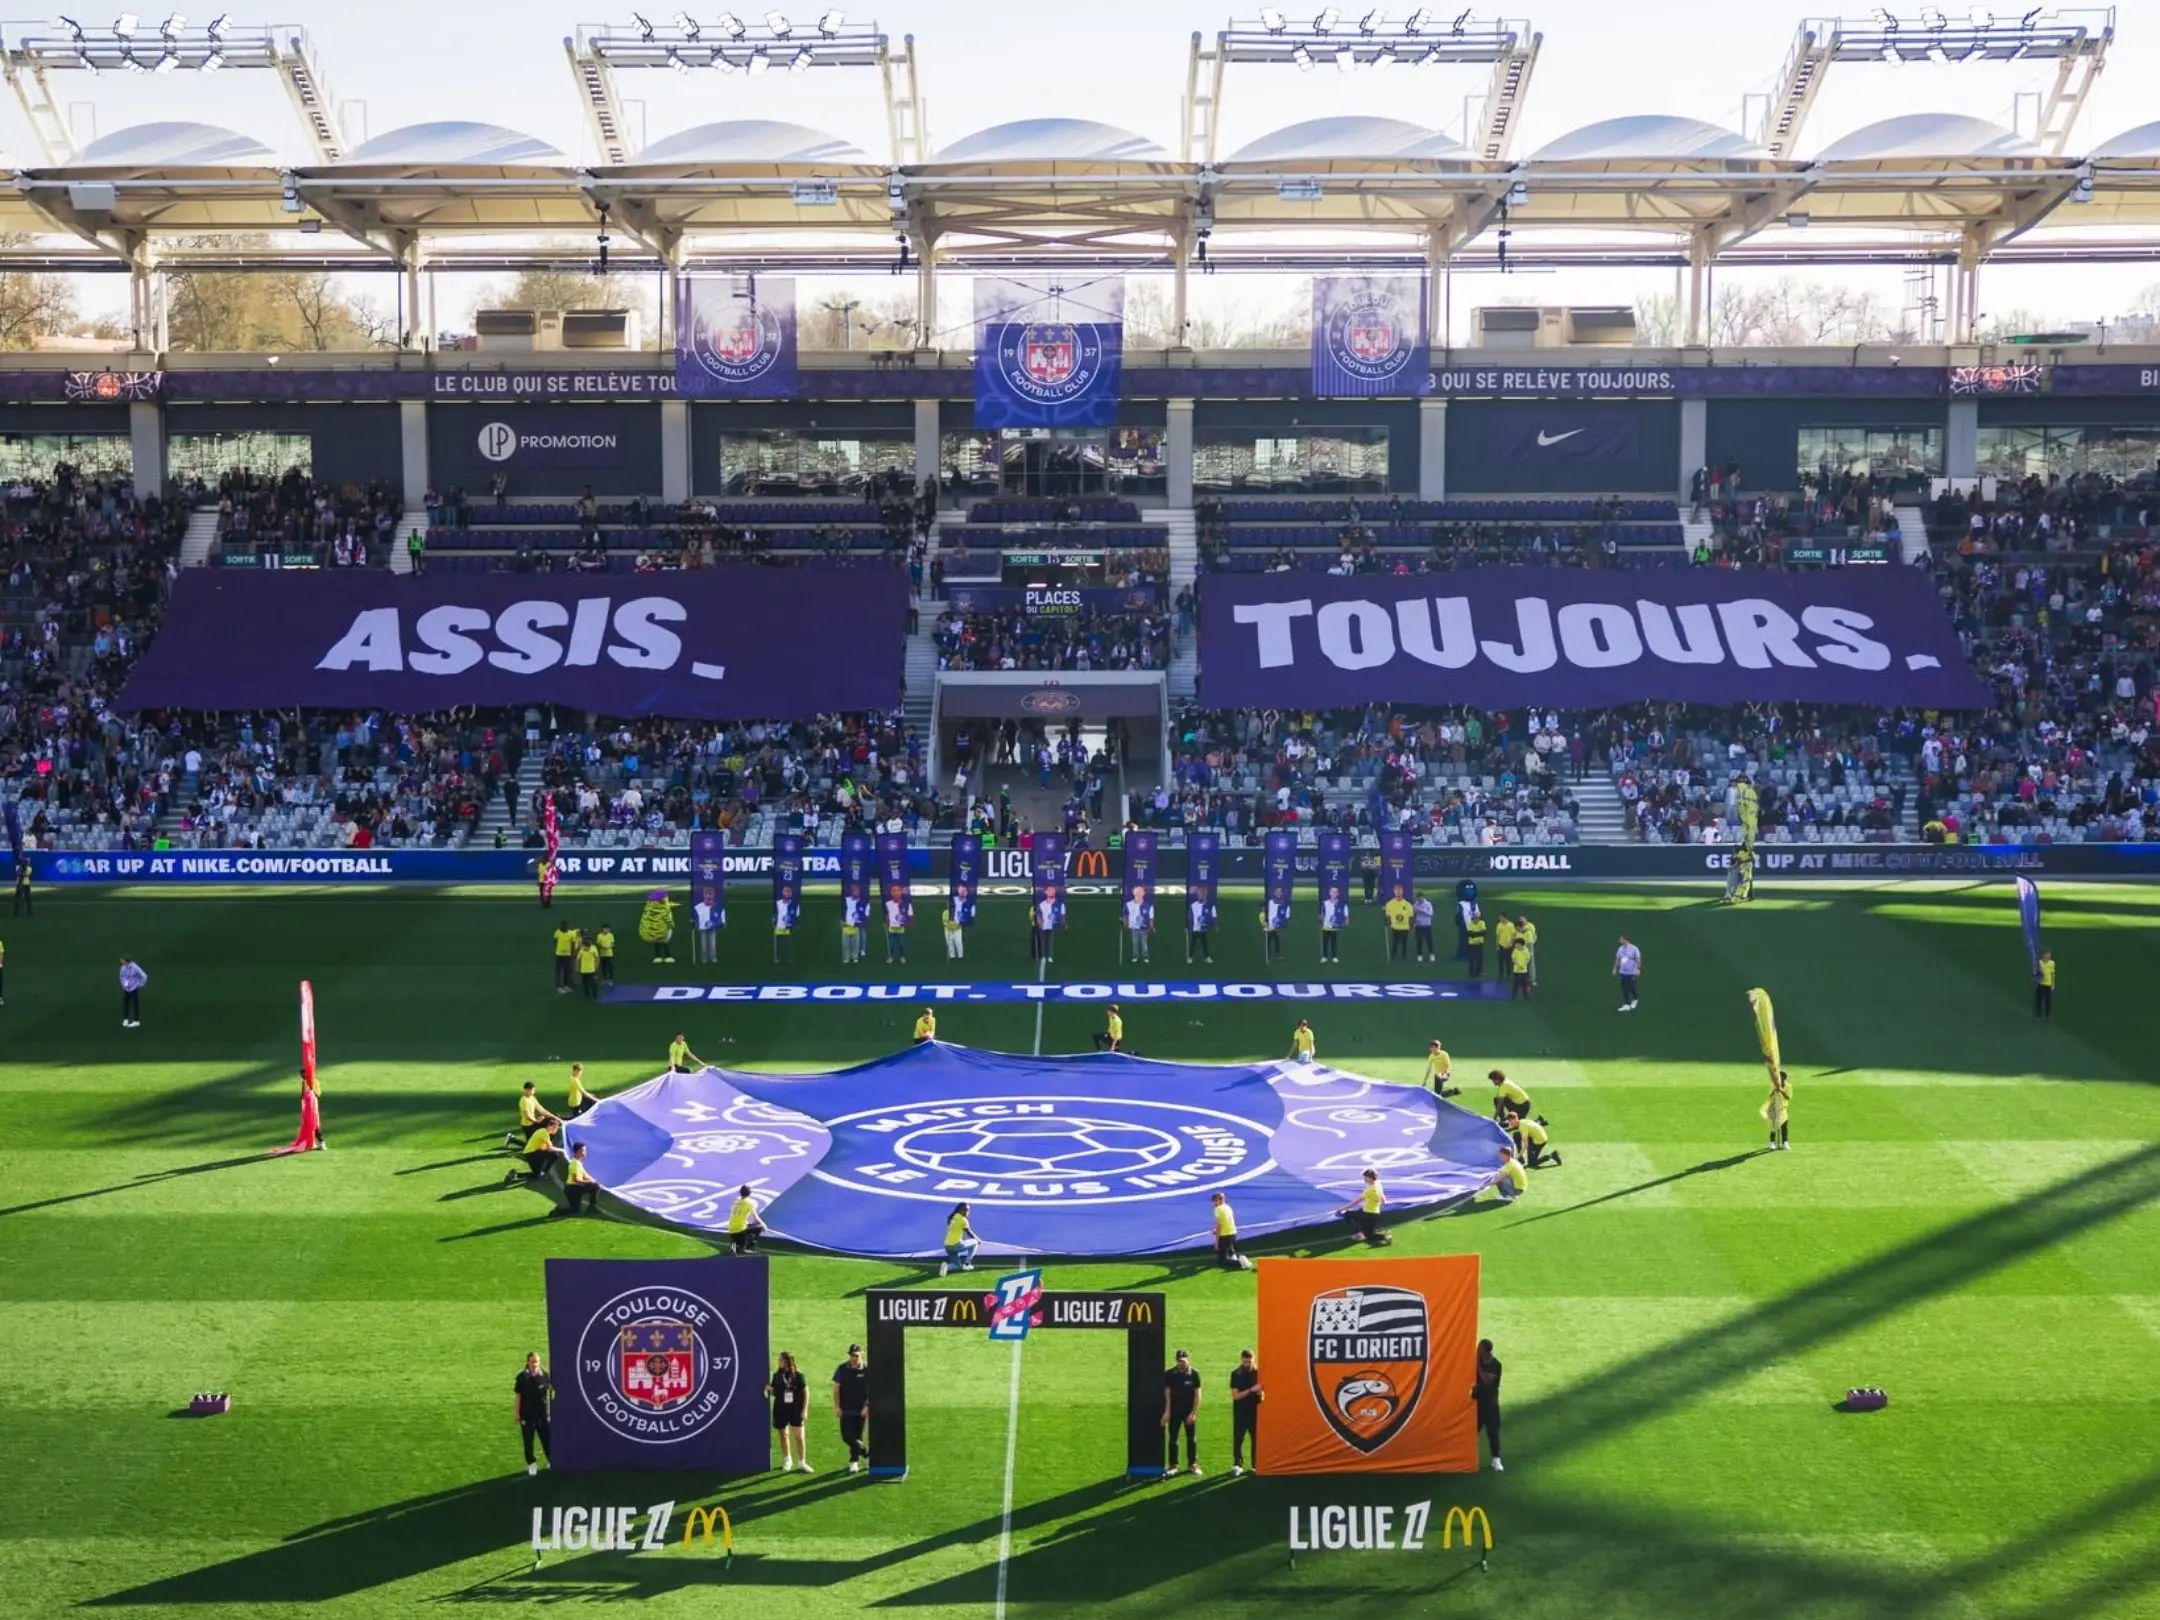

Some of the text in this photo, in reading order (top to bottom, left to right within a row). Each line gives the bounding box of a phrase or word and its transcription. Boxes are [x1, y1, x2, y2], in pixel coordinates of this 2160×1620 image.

[1003, 348, 1014, 357] 19
[1084, 348, 1097, 357] 37
[1339, 350, 1406, 374] FOOTBALL CLUB
[703, 352, 771, 376] FOOTBALL CLUB
[434, 376, 456, 392] LE
[461, 376, 508, 392] CLUB
[512, 376, 542, 394] QUI
[547, 376, 569, 392] SE
[574, 371, 642, 392] RELÈVE
[1011, 370, 1089, 397] FOOTBALL CLUB
[1442, 372, 1470, 390] QUI
[1476, 372, 1498, 388] SE
[1503, 368, 1571, 389] RELÈVE
[1577, 372, 1676, 389] TOUJOURS.
[520, 435, 617, 448] PROMOTION
[226, 553, 314, 569] SORTIE 11 SORTIE
[1010, 555, 1040, 563] SORTIE
[1065, 555, 1094, 563] SORTIE
[1793, 550, 1823, 558] SORTIE
[1852, 550, 1883, 558] SORTIE
[1026, 590, 1081, 605] PLACES
[1026, 605, 1038, 614] DU
[313, 596, 726, 680] ASSIS.
[1233, 596, 1941, 675] TOUJOURS.
[116, 858, 144, 873] UP
[150, 858, 176, 873] AT
[182, 858, 393, 873] NIKE.COM/FOOTBALL
[587, 857, 616, 873] UP
[620, 857, 646, 872] AT
[1766, 854, 1795, 869] UP
[1800, 854, 1827, 869] AT
[653, 983, 1459, 1000] DEBOUT. TOUJOURS.
[856, 1103, 1055, 1133] MATCH
[854, 1124, 1248, 1197] LE PLUS INCLUSIF
[604, 1296, 711, 1327] TOULOUSE
[879, 1299, 930, 1321] LIGUE
[1053, 1300, 1104, 1322] LIGUE
[1313, 1336, 1424, 1359] FC LORIENT
[585, 1359, 601, 1373] 19
[712, 1357, 731, 1370] 37
[597, 1390, 720, 1433] FOOTBALL CLUB
[532, 1505, 638, 1550] LIGUE
[1289, 1504, 1396, 1549] LIGUE
